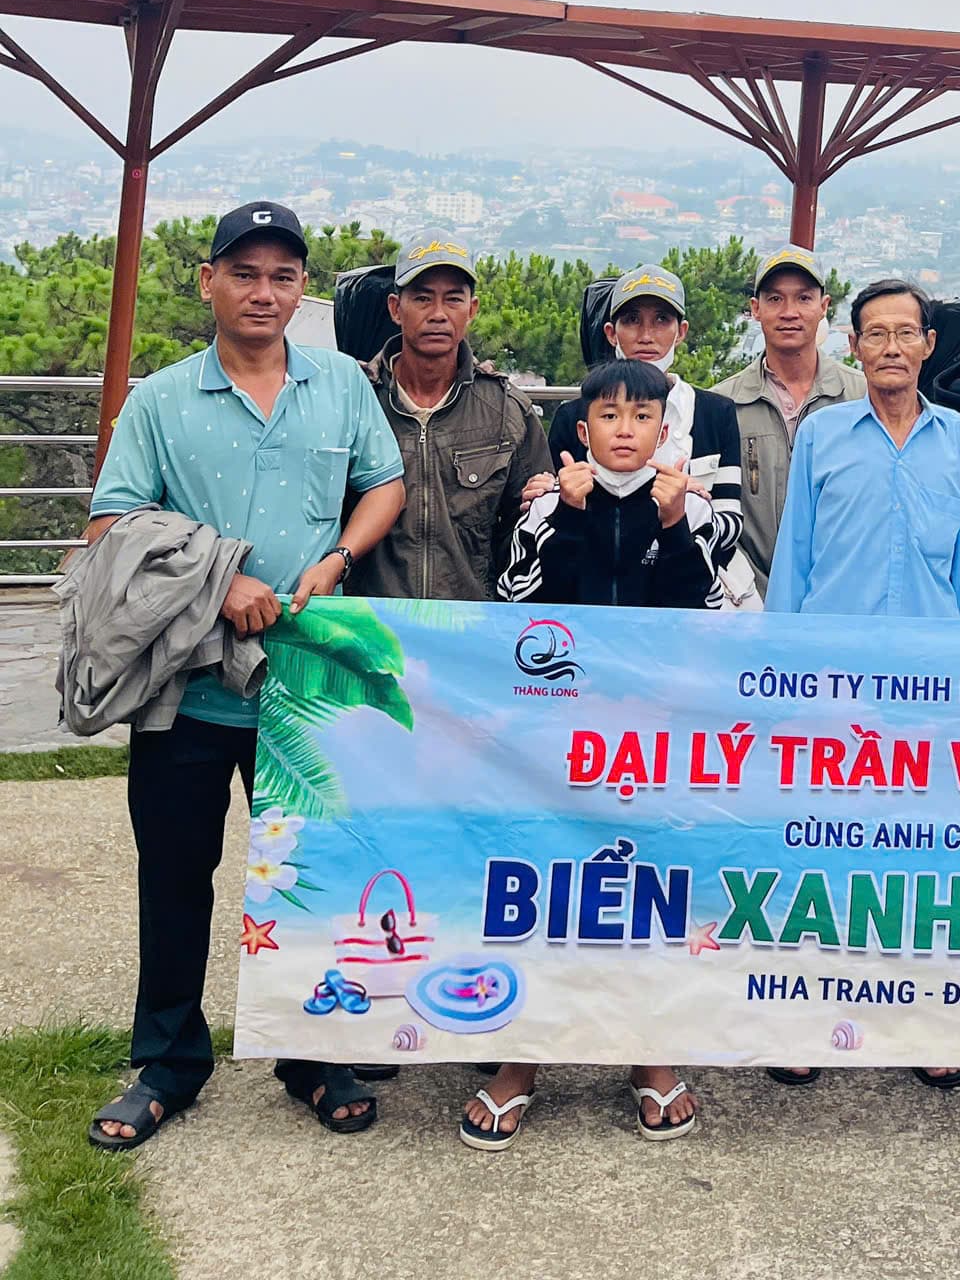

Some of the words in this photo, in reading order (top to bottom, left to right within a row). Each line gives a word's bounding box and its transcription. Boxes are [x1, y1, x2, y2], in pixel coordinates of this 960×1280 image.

[252, 210, 272, 224] G
[513, 685, 549, 697] THĂNG
[551, 687, 579, 698] LONG
[739, 666, 818, 699] CÔNG
[828, 674, 865, 700] TY
[872, 675, 950, 702] TNHH
[566, 729, 671, 798] ĐẠI
[690, 722, 756, 787] LÝ
[770, 723, 932, 789] TRẦN
[784, 815, 864, 848] CÙNG
[872, 822, 934, 849] ANH
[483, 838, 688, 941] BIỂN
[747, 974, 809, 1001] NHA
[818, 977, 916, 1004] TRANG
